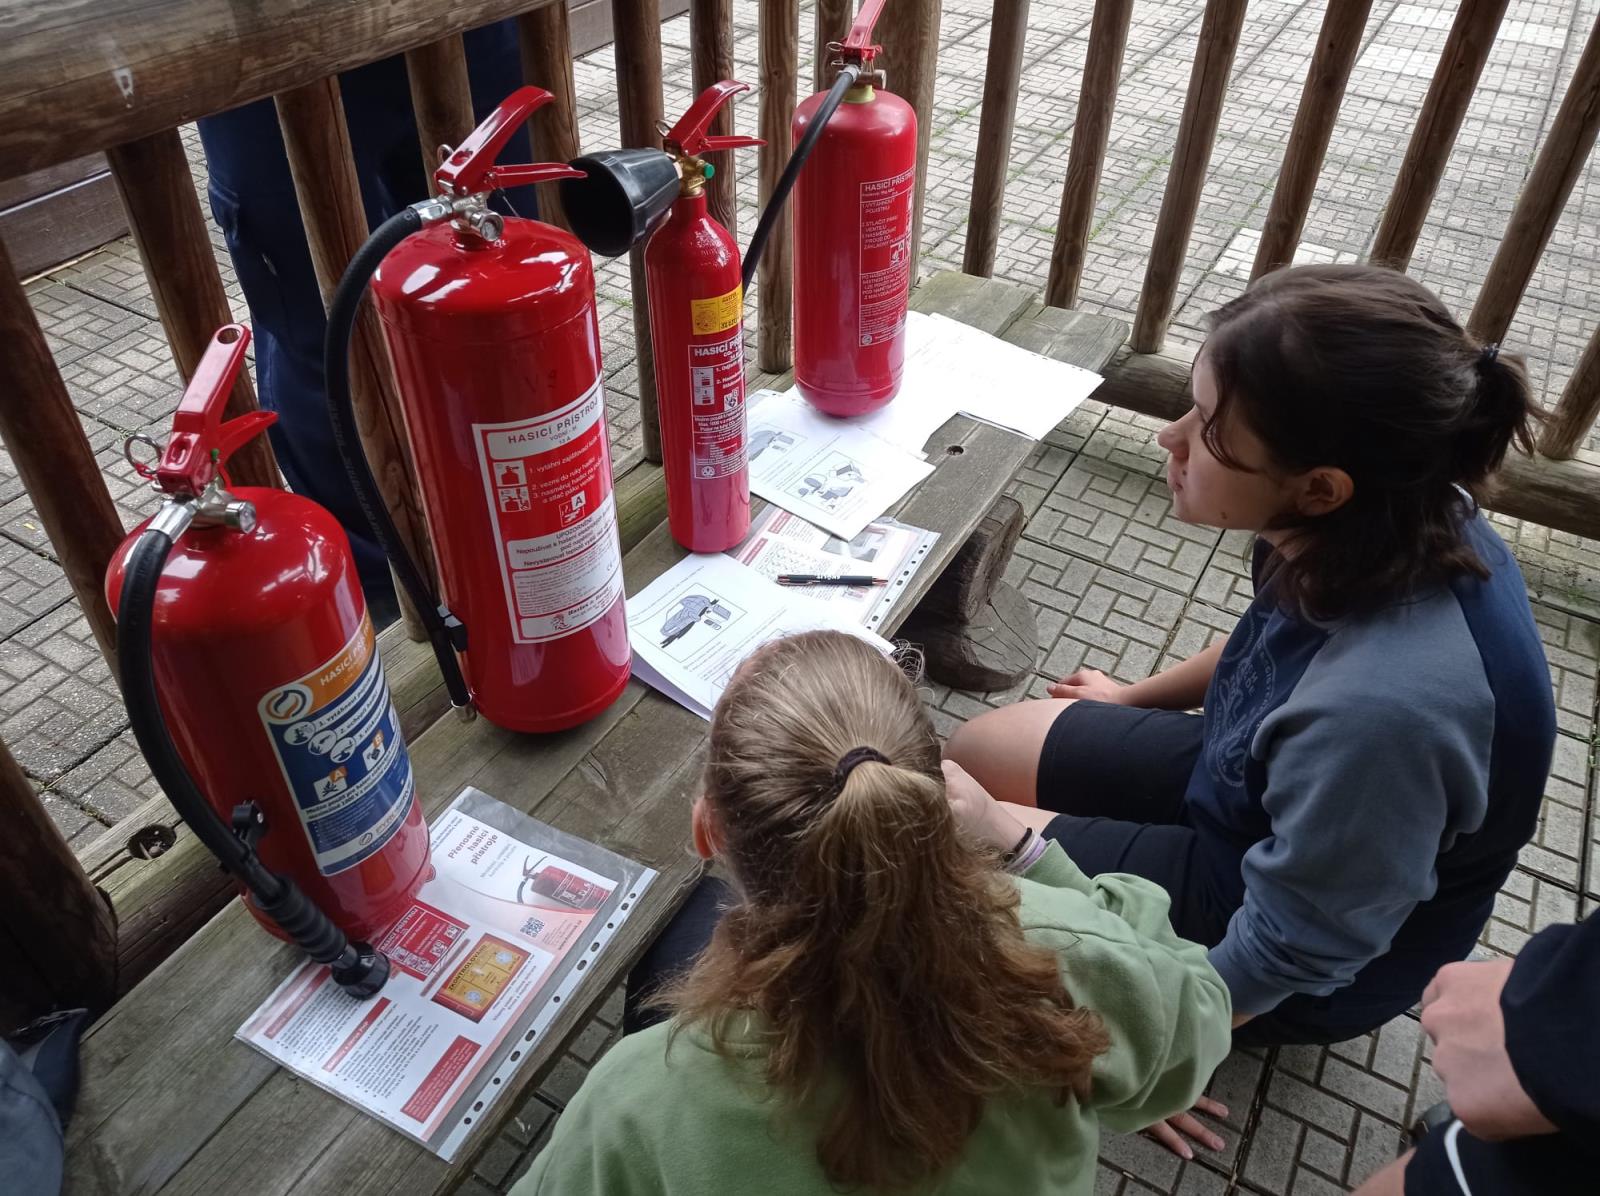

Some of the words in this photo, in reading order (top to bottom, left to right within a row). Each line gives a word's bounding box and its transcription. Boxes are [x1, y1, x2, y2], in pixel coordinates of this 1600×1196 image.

[865, 181, 889, 190] HASICÍ
[694, 342, 727, 355] HASICÍ
[507, 426, 553, 443] HASICÍ
[556, 396, 598, 431] PŘÍSTROJ
[559, 472, 568, 481] do
[576, 496, 583, 505] A
[319, 653, 352, 685] HASICÍ
[374, 735, 383, 747] B
[333, 769, 344, 779] A
[447, 824, 479, 859] Přenosné
[467, 828, 488, 851] hasicí
